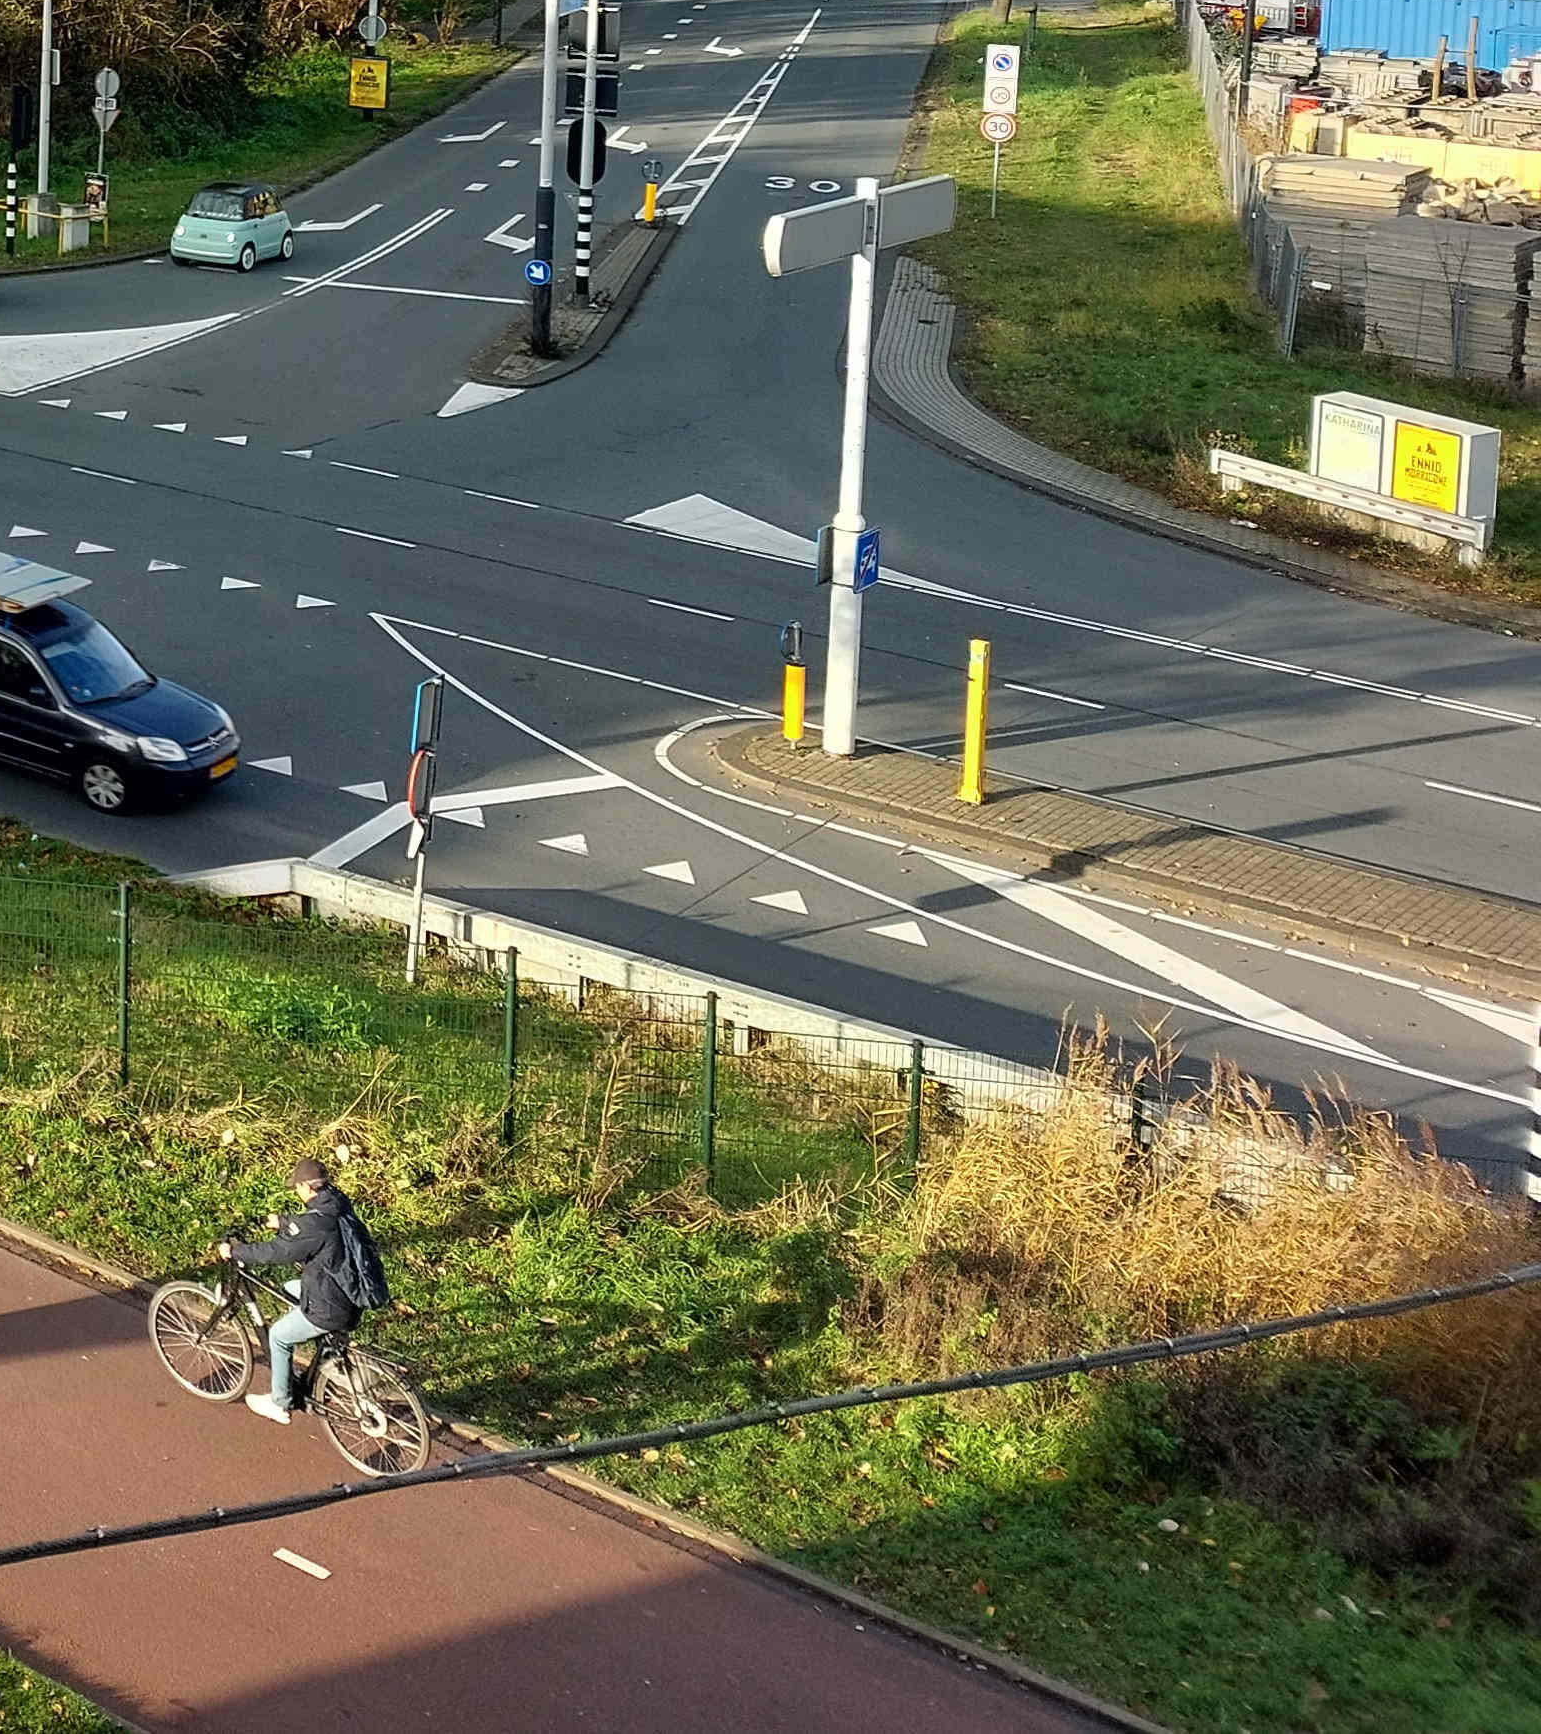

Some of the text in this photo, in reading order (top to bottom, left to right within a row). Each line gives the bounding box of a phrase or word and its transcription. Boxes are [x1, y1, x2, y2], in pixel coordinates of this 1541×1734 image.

[988, 121, 1009, 133] 30
[765, 175, 841, 193] 30
[1325, 412, 1381, 435] KATHARINA
[1411, 456, 1442, 473] ENNIO
